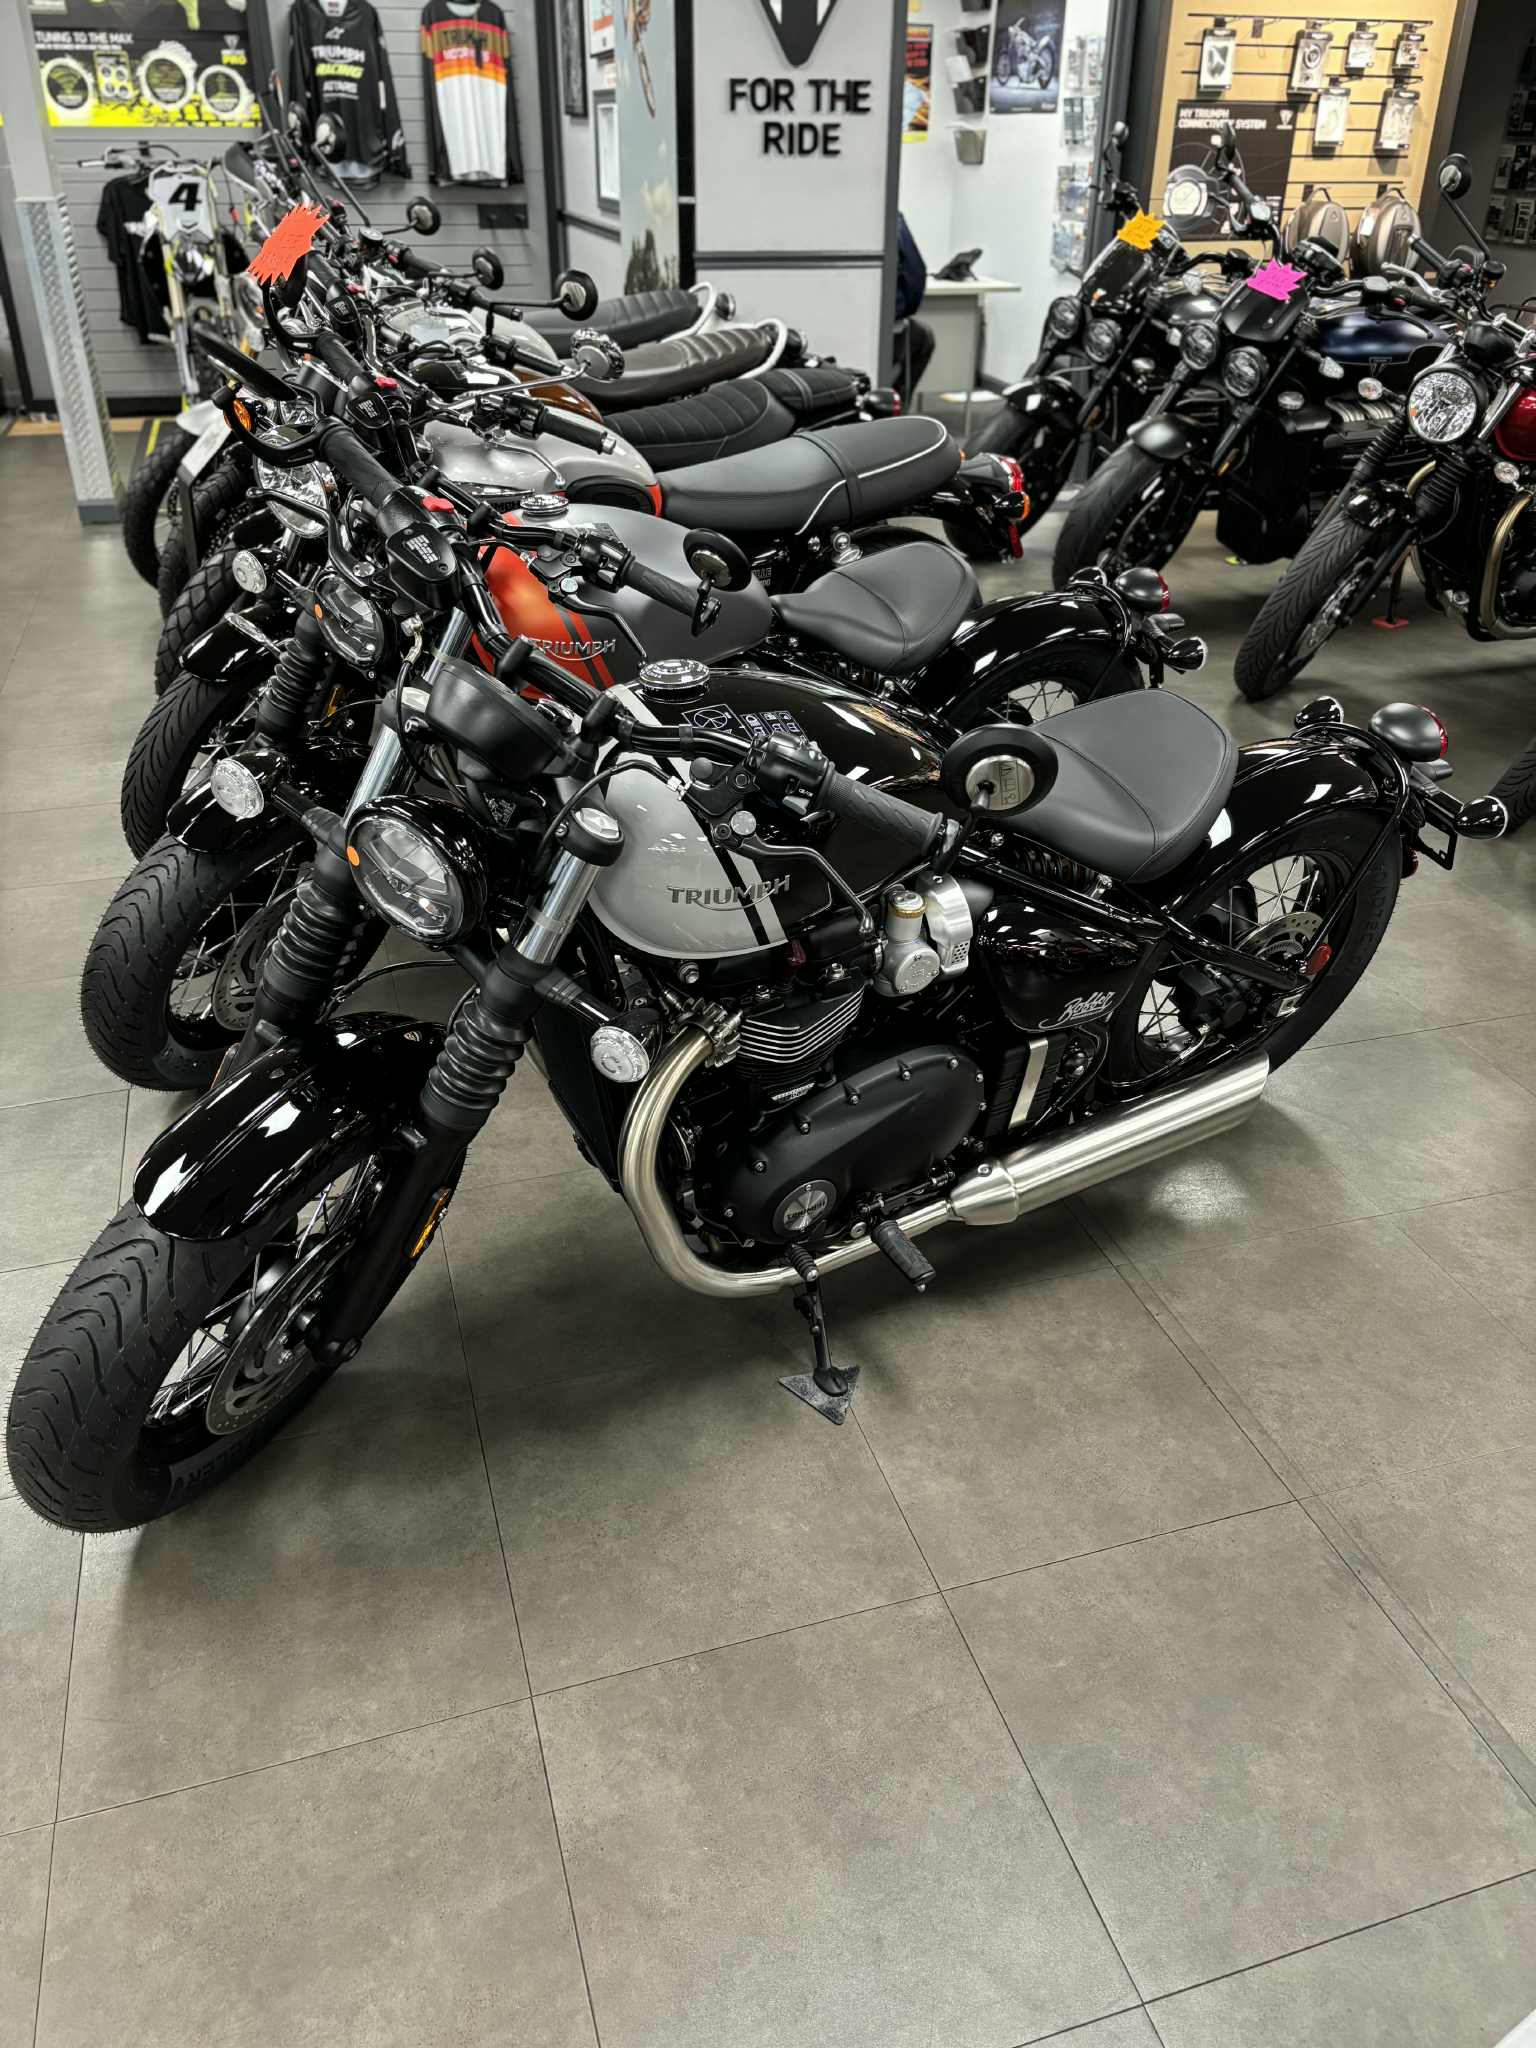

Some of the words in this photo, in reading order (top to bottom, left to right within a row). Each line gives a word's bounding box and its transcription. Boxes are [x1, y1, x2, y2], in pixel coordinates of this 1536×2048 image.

[35, 31, 71, 44] TUNING
[72, 31, 88, 44] TO
[88, 32, 108, 44] THE
[109, 32, 135, 44] MAX
[311, 45, 365, 63] TRIUMPH
[315, 63, 364, 79] RACING
[728, 78, 795, 112] FOR
[807, 79, 871, 114] THE
[1180, 108, 1192, 118] MY
[1194, 108, 1230, 119] TRIUMPH
[1235, 119, 1267, 129] SYSTEM
[763, 122, 841, 156] RIDE
[168, 183, 202, 211] 4
[667, 874, 790, 911] TRIUMPH
[1040, 991, 1116, 1028] Bobber
